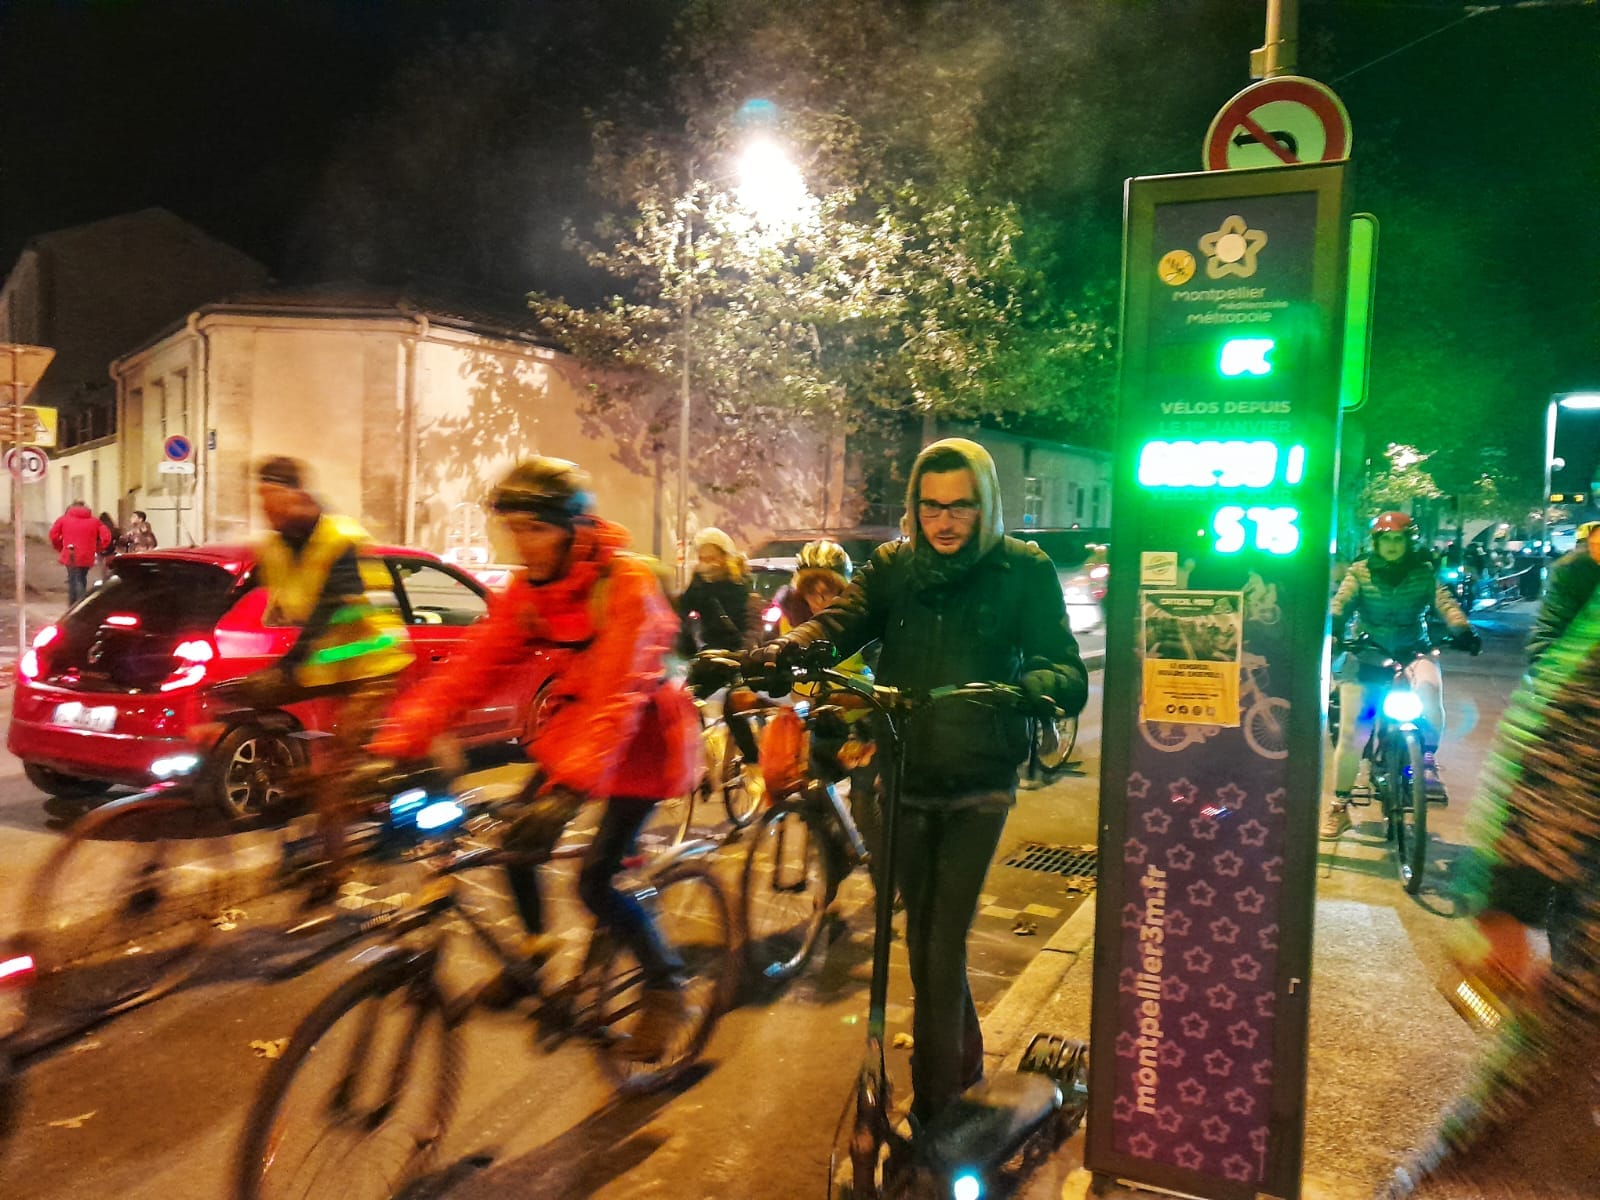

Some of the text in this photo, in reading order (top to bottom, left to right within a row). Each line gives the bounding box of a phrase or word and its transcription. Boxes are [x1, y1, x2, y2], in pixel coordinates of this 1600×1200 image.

[1172, 287, 1266, 302] montpellier
[1224, 401, 1291, 413] DEPUIS
[1210, 420, 1291, 433] JANVIER
[1136, 864, 1167, 1115] montpellier3m.fr
